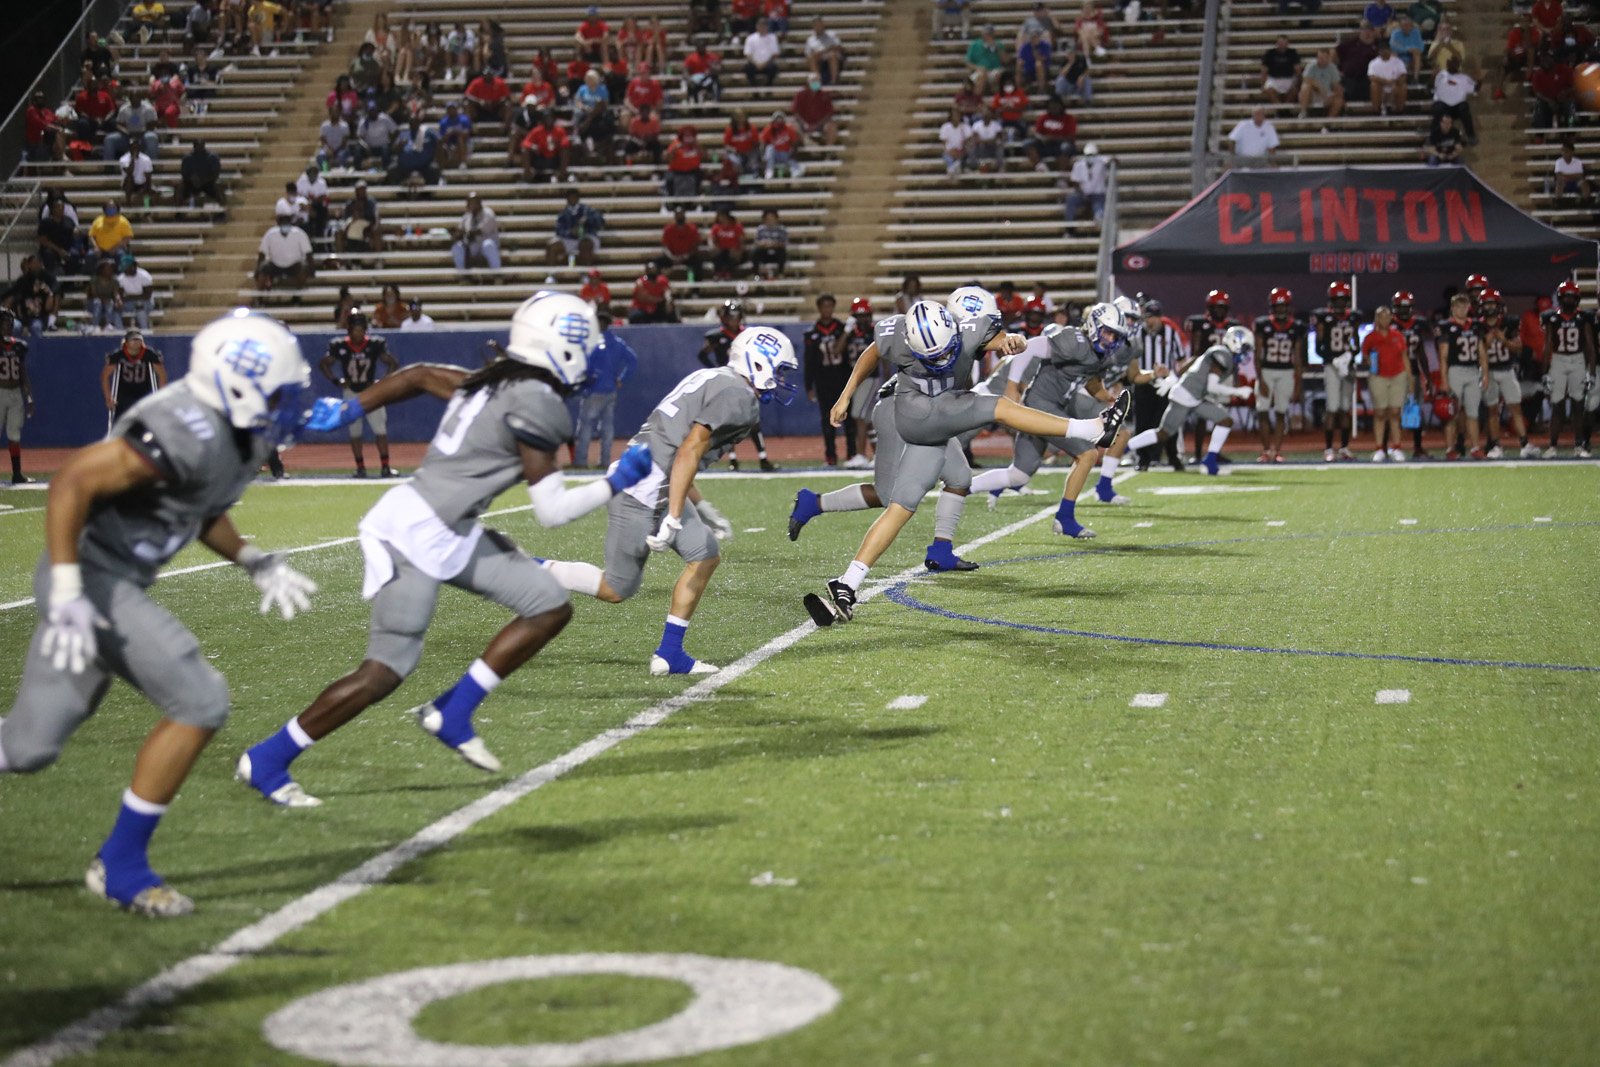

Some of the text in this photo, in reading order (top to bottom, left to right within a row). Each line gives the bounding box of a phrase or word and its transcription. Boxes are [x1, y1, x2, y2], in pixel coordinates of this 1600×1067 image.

[1217, 187, 1487, 245] CLINTON
[1309, 252, 1399, 273] ARROWS
[1266, 339, 1292, 363] 29
[1456, 336, 1477, 361] 32
[1557, 328, 1579, 352] 19
[0, 357, 20, 380] 36
[122, 361, 147, 383] 50
[347, 359, 371, 383] 47
